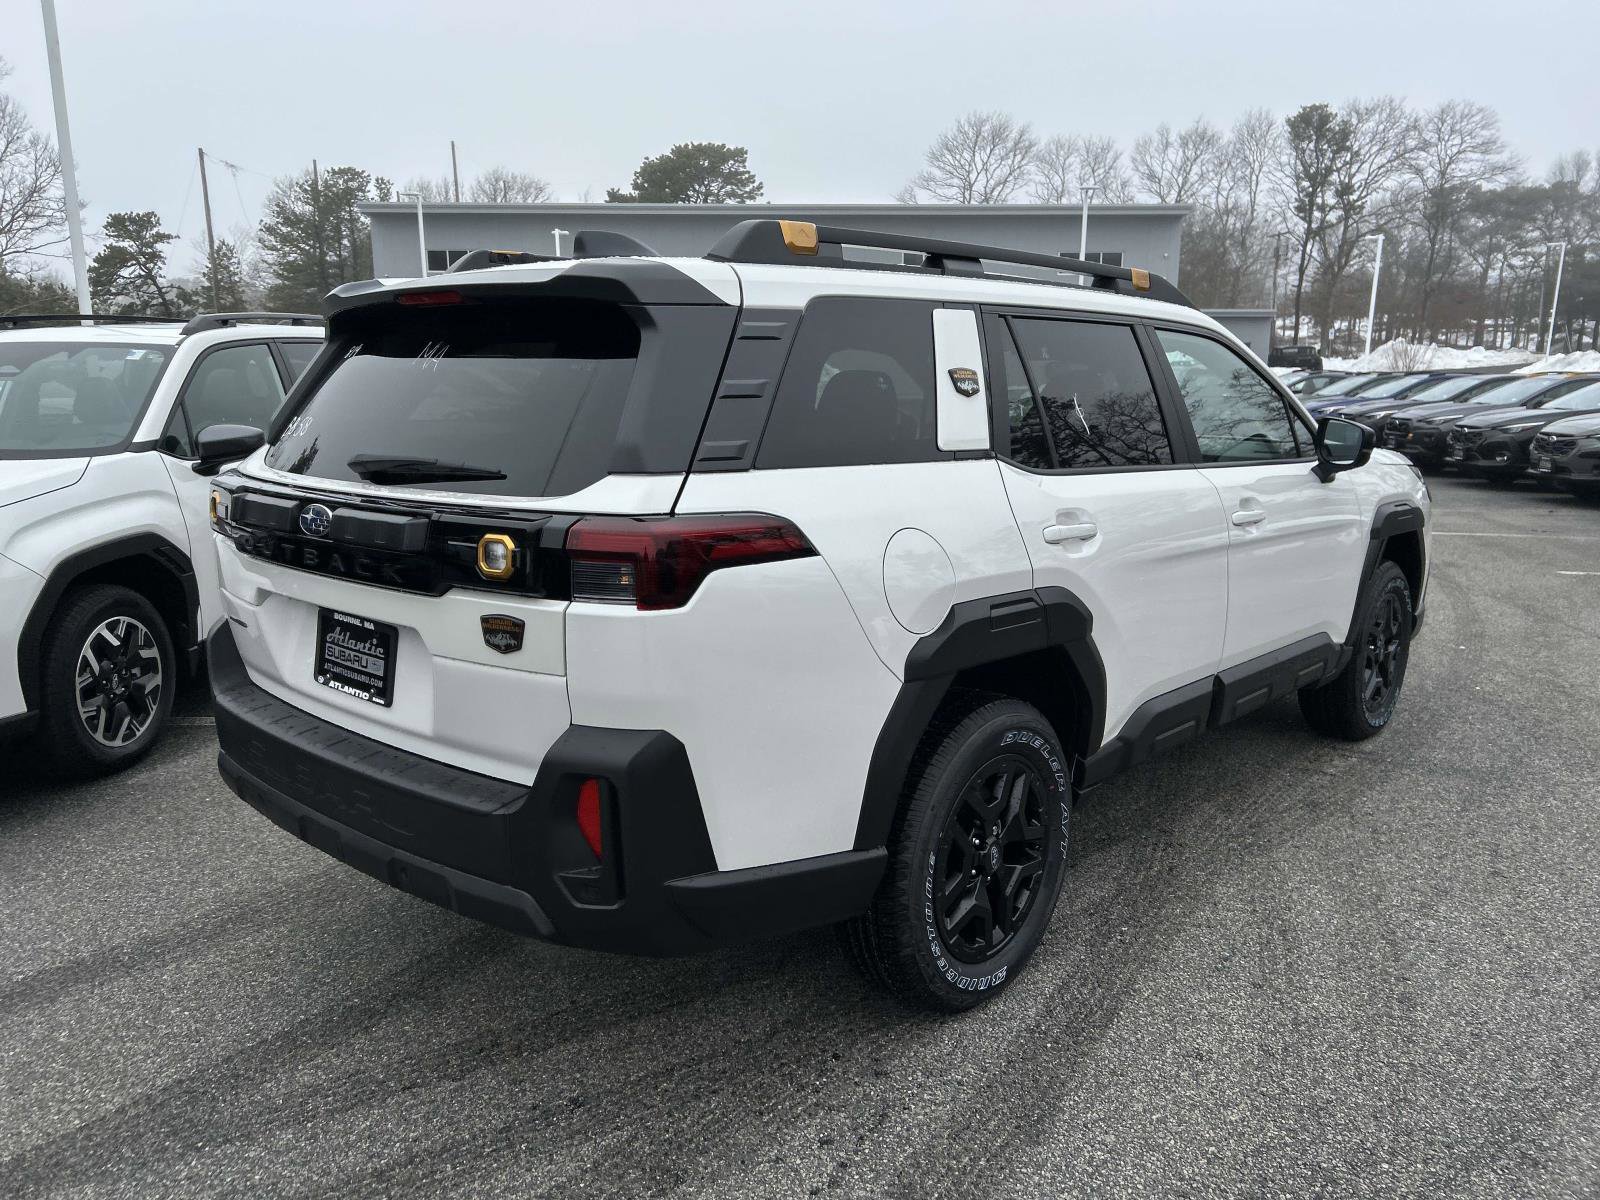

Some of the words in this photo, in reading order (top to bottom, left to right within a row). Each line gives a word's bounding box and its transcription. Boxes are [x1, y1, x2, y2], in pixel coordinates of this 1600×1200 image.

[363, 620, 375, 630] MA
[326, 626, 385, 658] Atlantic
[326, 644, 369, 669] SUBARU
[324, 662, 383, 688] ATLANTICSUBARU.COM
[328, 680, 370, 700] ATLANTIC
[1000, 730, 1066, 792] DUELER
[1059, 802, 1070, 860] A/T
[924, 850, 1009, 991] BRIDGESTONE
